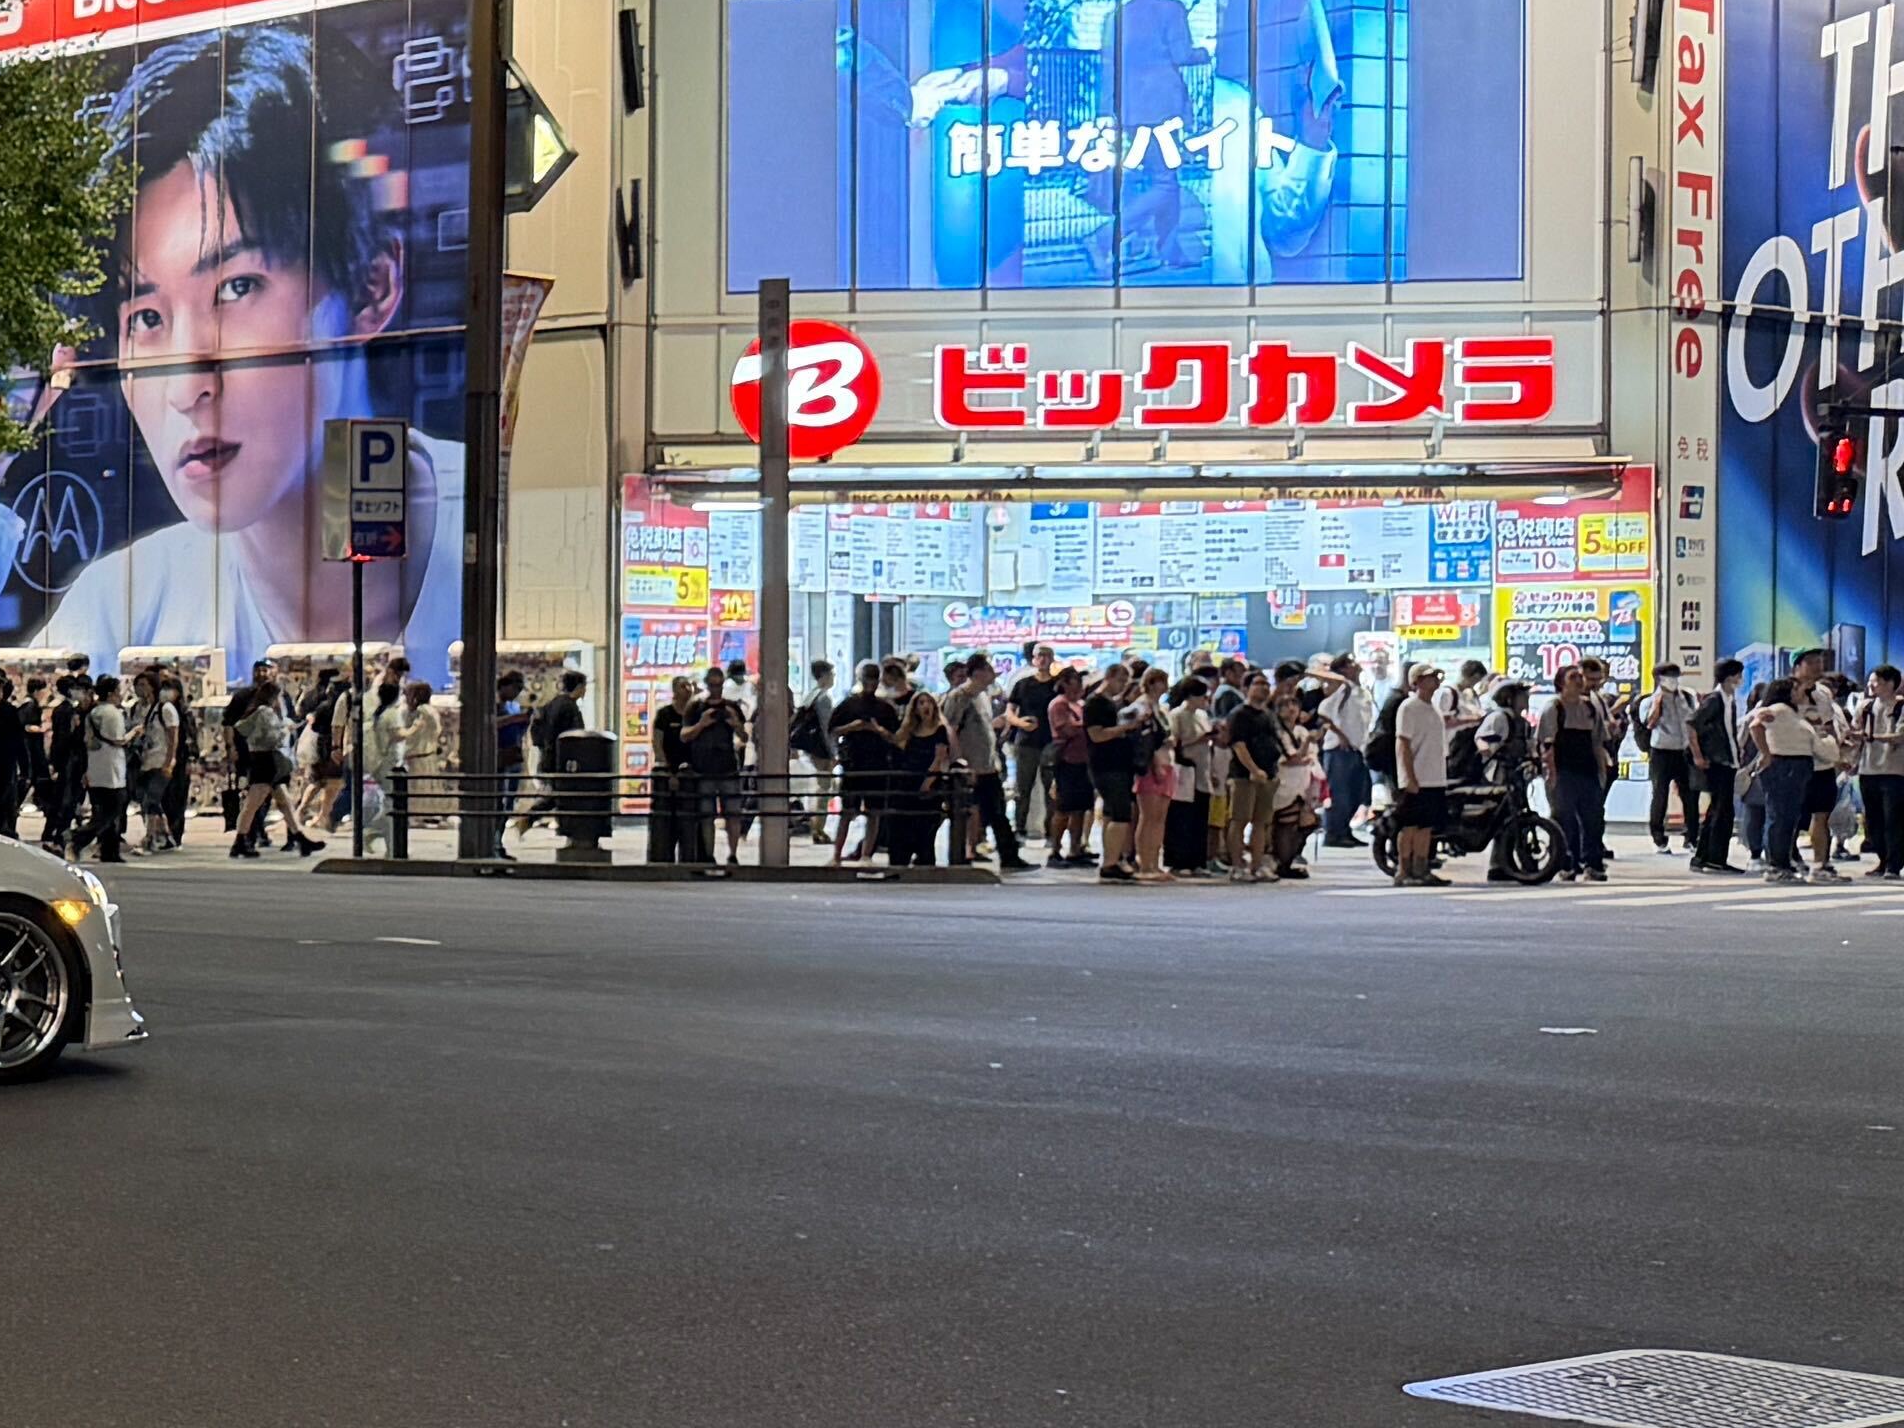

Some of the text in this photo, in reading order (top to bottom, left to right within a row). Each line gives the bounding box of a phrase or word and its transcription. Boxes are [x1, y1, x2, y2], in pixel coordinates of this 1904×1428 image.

[948, 117, 1295, 177] 簡単なバイト
[1675, 171, 1713, 378] Free
[934, 335, 1555, 430] ビックカメラ
[360, 431, 395, 482] P
[1437, 506, 1485, 520] Wi-Fi
[1617, 542, 1645, 553] OFF
